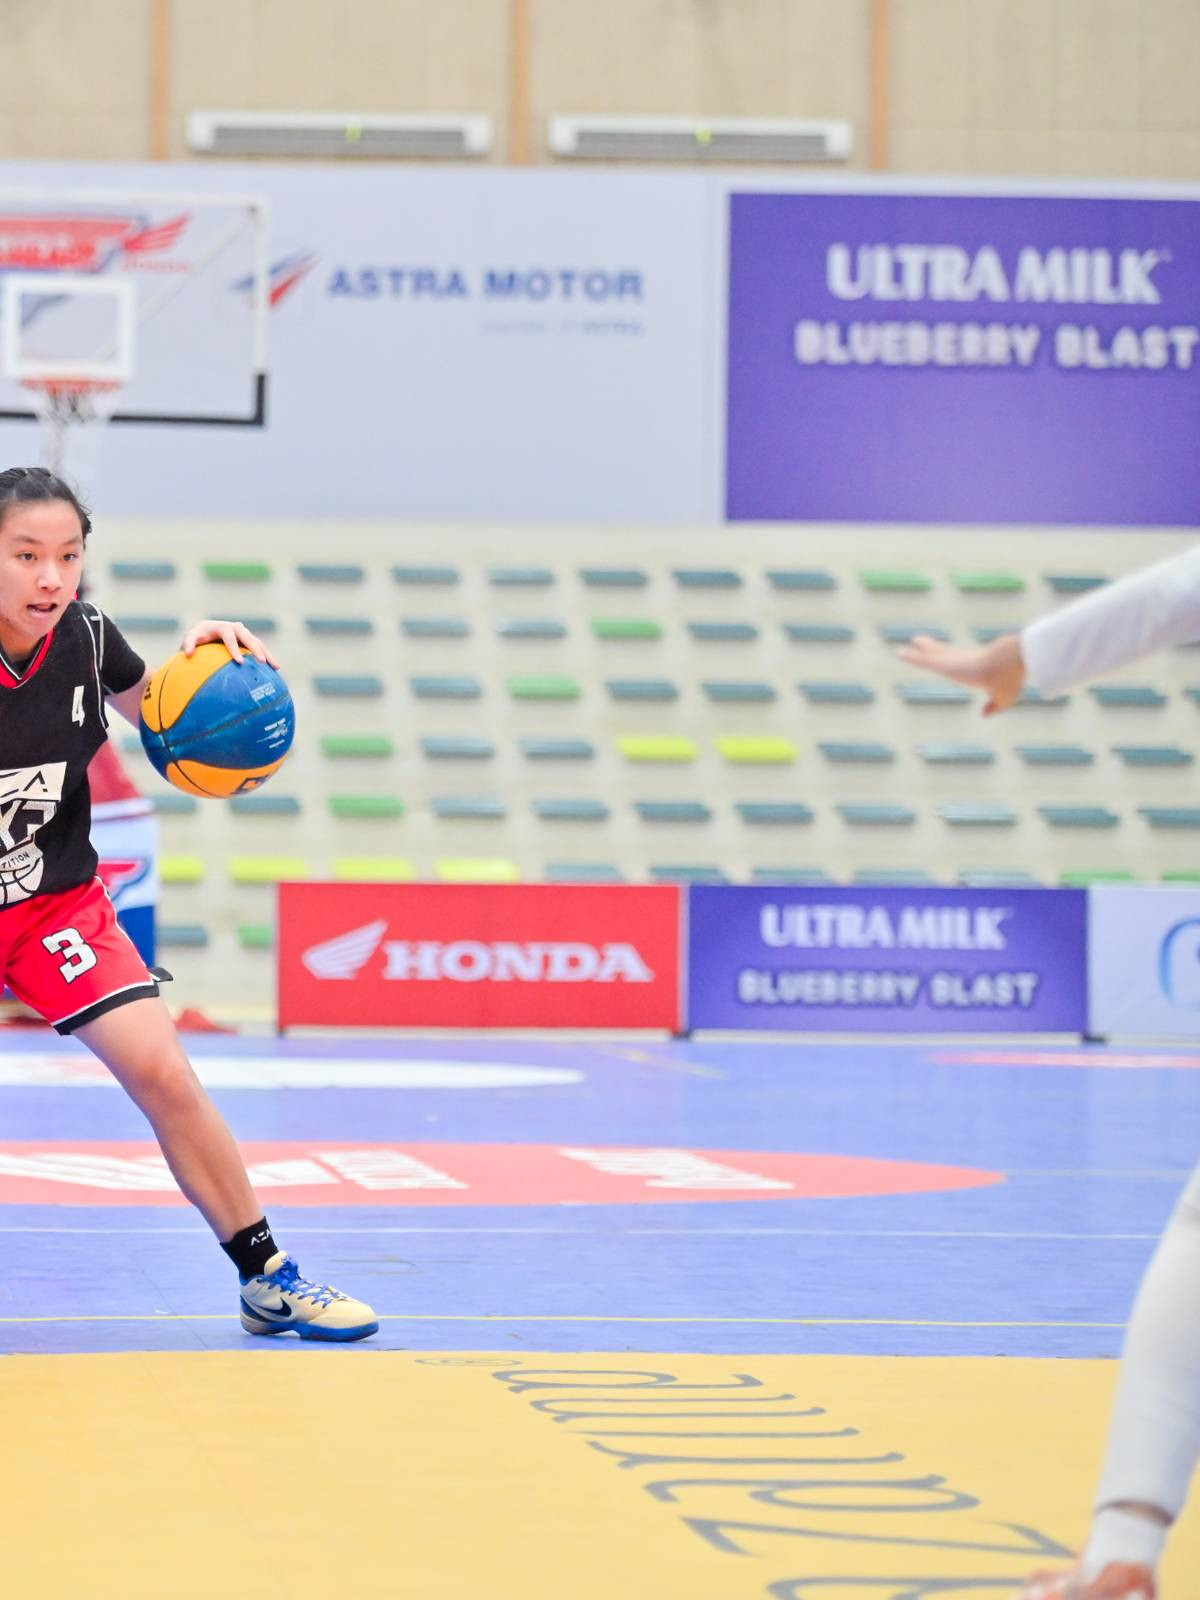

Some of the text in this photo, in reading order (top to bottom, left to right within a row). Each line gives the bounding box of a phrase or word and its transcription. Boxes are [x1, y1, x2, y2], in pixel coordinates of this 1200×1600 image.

[328, 268, 643, 300] ASTRA MOTOR
[826, 243, 1162, 304] ULTRA MILK
[795, 320, 1199, 370] BLUEBERRY BLAST
[761, 905, 1006, 951] ULTRA MILK
[41, 927, 98, 985] 3
[384, 940, 655, 983] HONDA
[738, 969, 1038, 1009] BLUEBERRY BLAST
